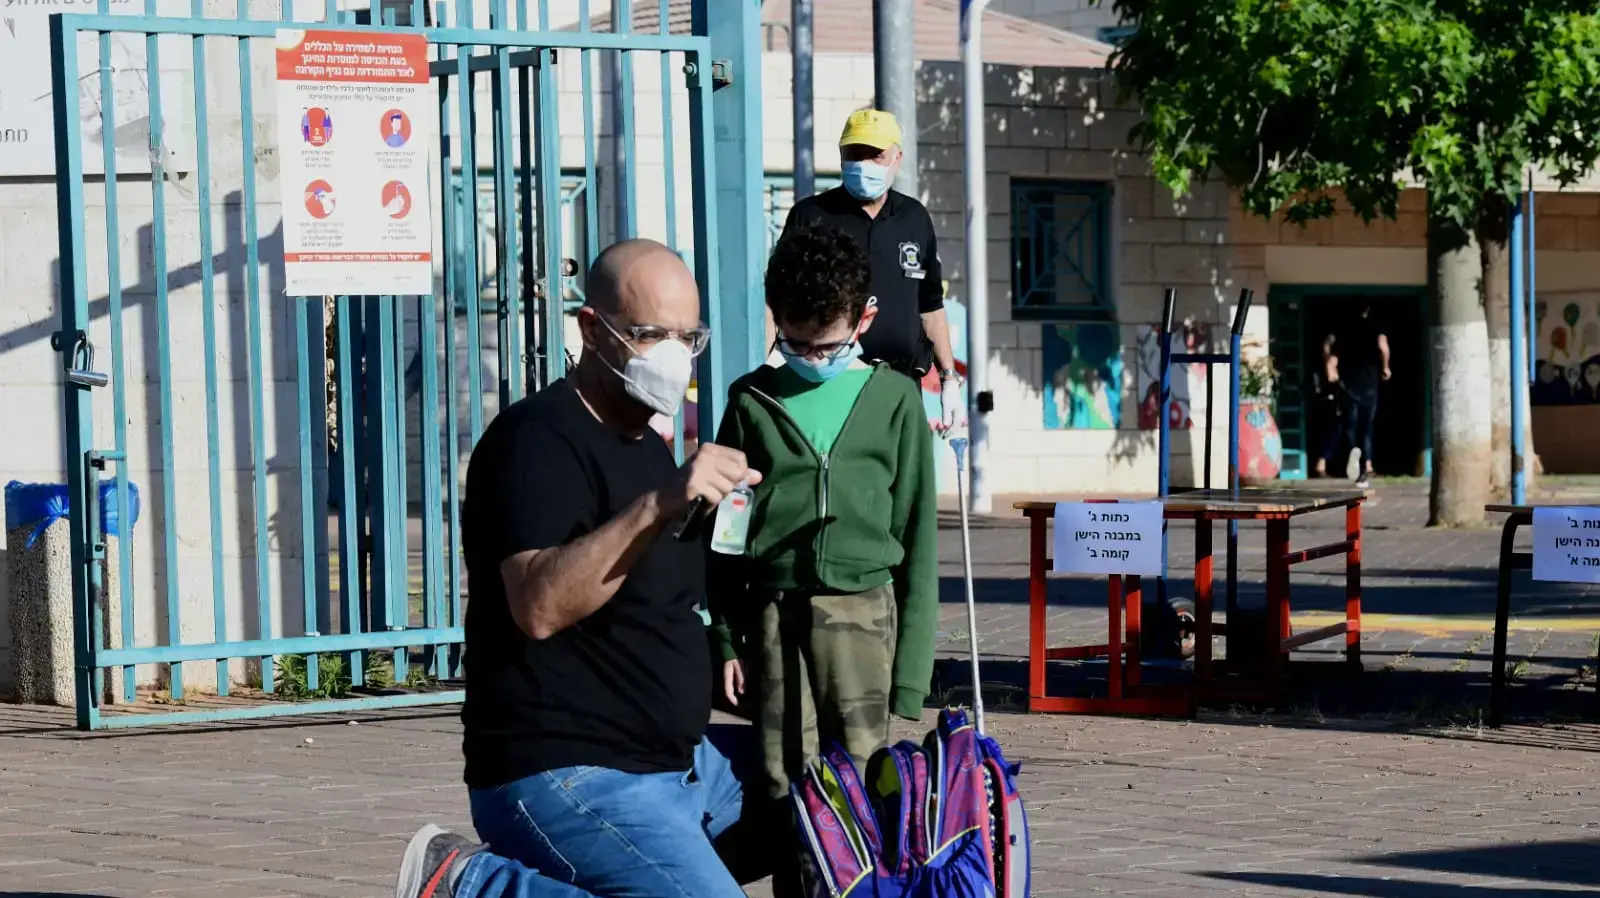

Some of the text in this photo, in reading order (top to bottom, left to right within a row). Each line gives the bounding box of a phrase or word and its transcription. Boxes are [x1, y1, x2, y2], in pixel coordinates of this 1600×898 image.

[304, 40, 332, 52] הכללים
[332, 41, 344, 52] על
[345, 42, 375, 53] לשמירה
[301, 53, 325, 66] החינוך
[327, 53, 359, 65] למוסדות
[361, 55, 388, 65] הכניסה
[295, 65, 324, 77] הקורונה
[326, 66, 341, 78] נגיף
[343, 67, 355, 76] עם
[397, 66, 415, 78] לאור
[0, 128, 28, 142] מת
[1101, 513, 1130, 522] כתות
[1075, 531, 1141, 541] במבנה הישן
[1555, 537, 1582, 549] הישן
[1101, 549, 1130, 561] קומה
